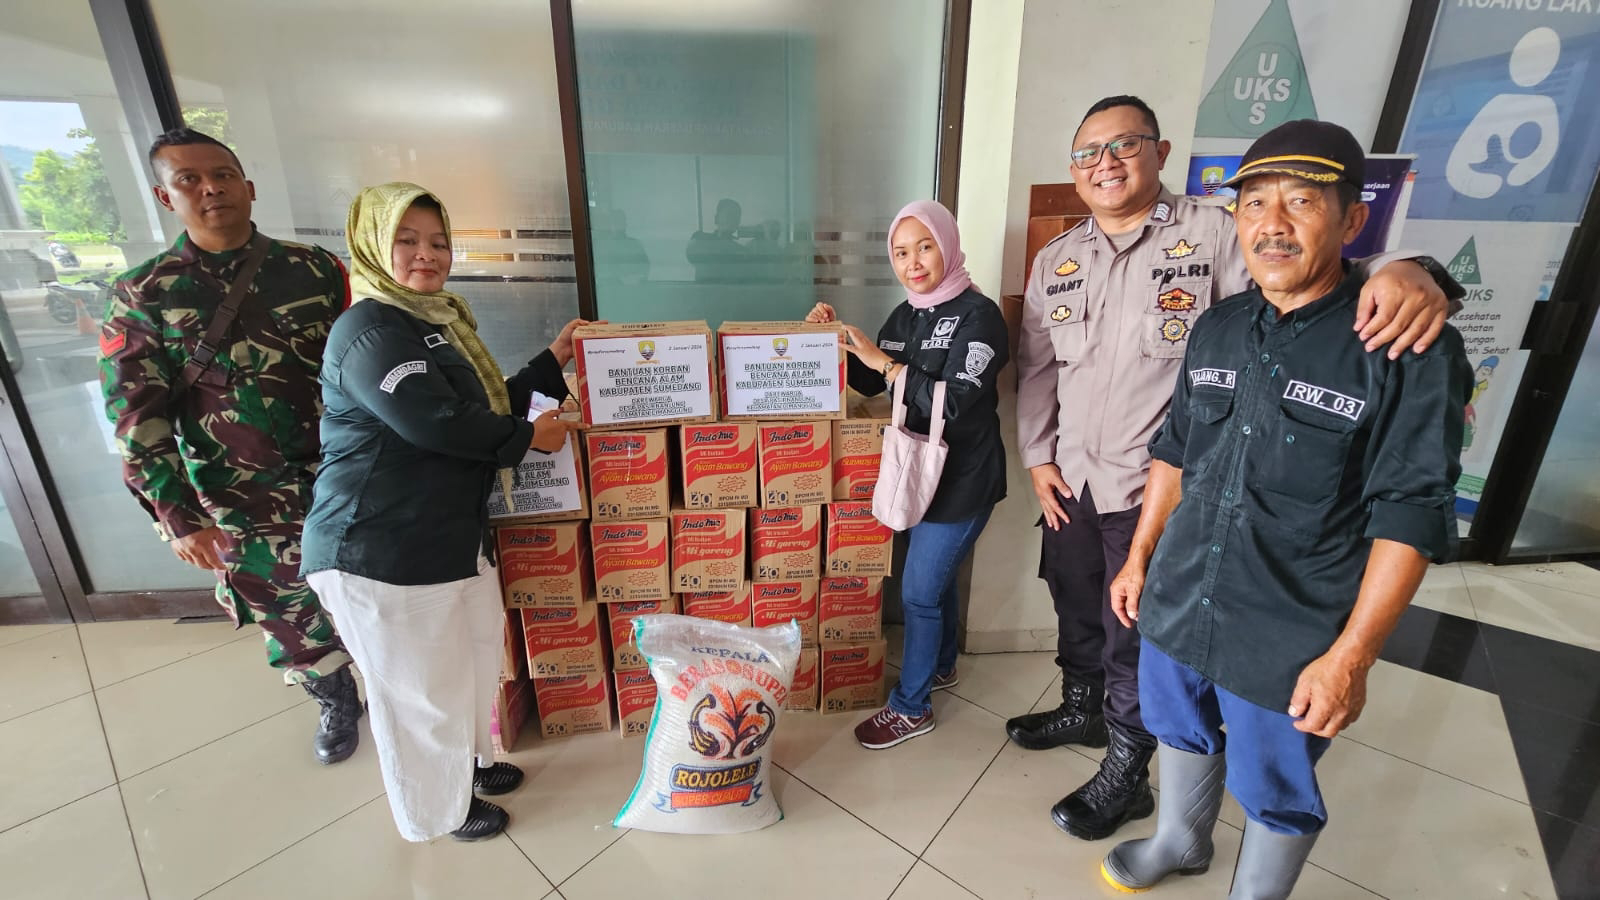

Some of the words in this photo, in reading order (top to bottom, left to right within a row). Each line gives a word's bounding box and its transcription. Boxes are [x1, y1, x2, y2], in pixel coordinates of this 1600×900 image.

[1548, 0, 1600, 13] LAK
[1258, 53, 1279, 76] U
[1234, 77, 1291, 102] UKS
[1248, 102, 1267, 125] S
[1460, 256, 1470, 265] U
[1152, 264, 1210, 280] POLRI
[1449, 264, 1475, 273] UKS
[1455, 273, 1463, 282] S
[1046, 279, 1084, 296] GIANT
[1482, 346, 1510, 355] Sehat
[608, 367, 651, 379] BANTUAN
[653, 365, 690, 377] KORBAN
[744, 363, 784, 373] BANTUAN
[786, 361, 821, 371] KORBAN
[615, 376, 657, 387] BENCANA
[659, 374, 685, 384] ALAM
[750, 372, 789, 381] BENCANA
[791, 370, 815, 380] ALAM
[1225, 373, 1233, 385] R
[599, 386, 651, 397] KABUPATEN
[653, 382, 702, 393] SUMEDANG
[736, 381, 784, 390] KABUPATEN
[786, 379, 832, 388] SUMEDANG
[1292, 385, 1326, 405] RW.
[1333, 397, 1356, 414] 03
[525, 470, 552, 480] ALAM
[519, 477, 570, 490] SUMEDANG
[691, 647, 770, 663] KEPALA
[677, 763, 759, 788] ROJOLELE
